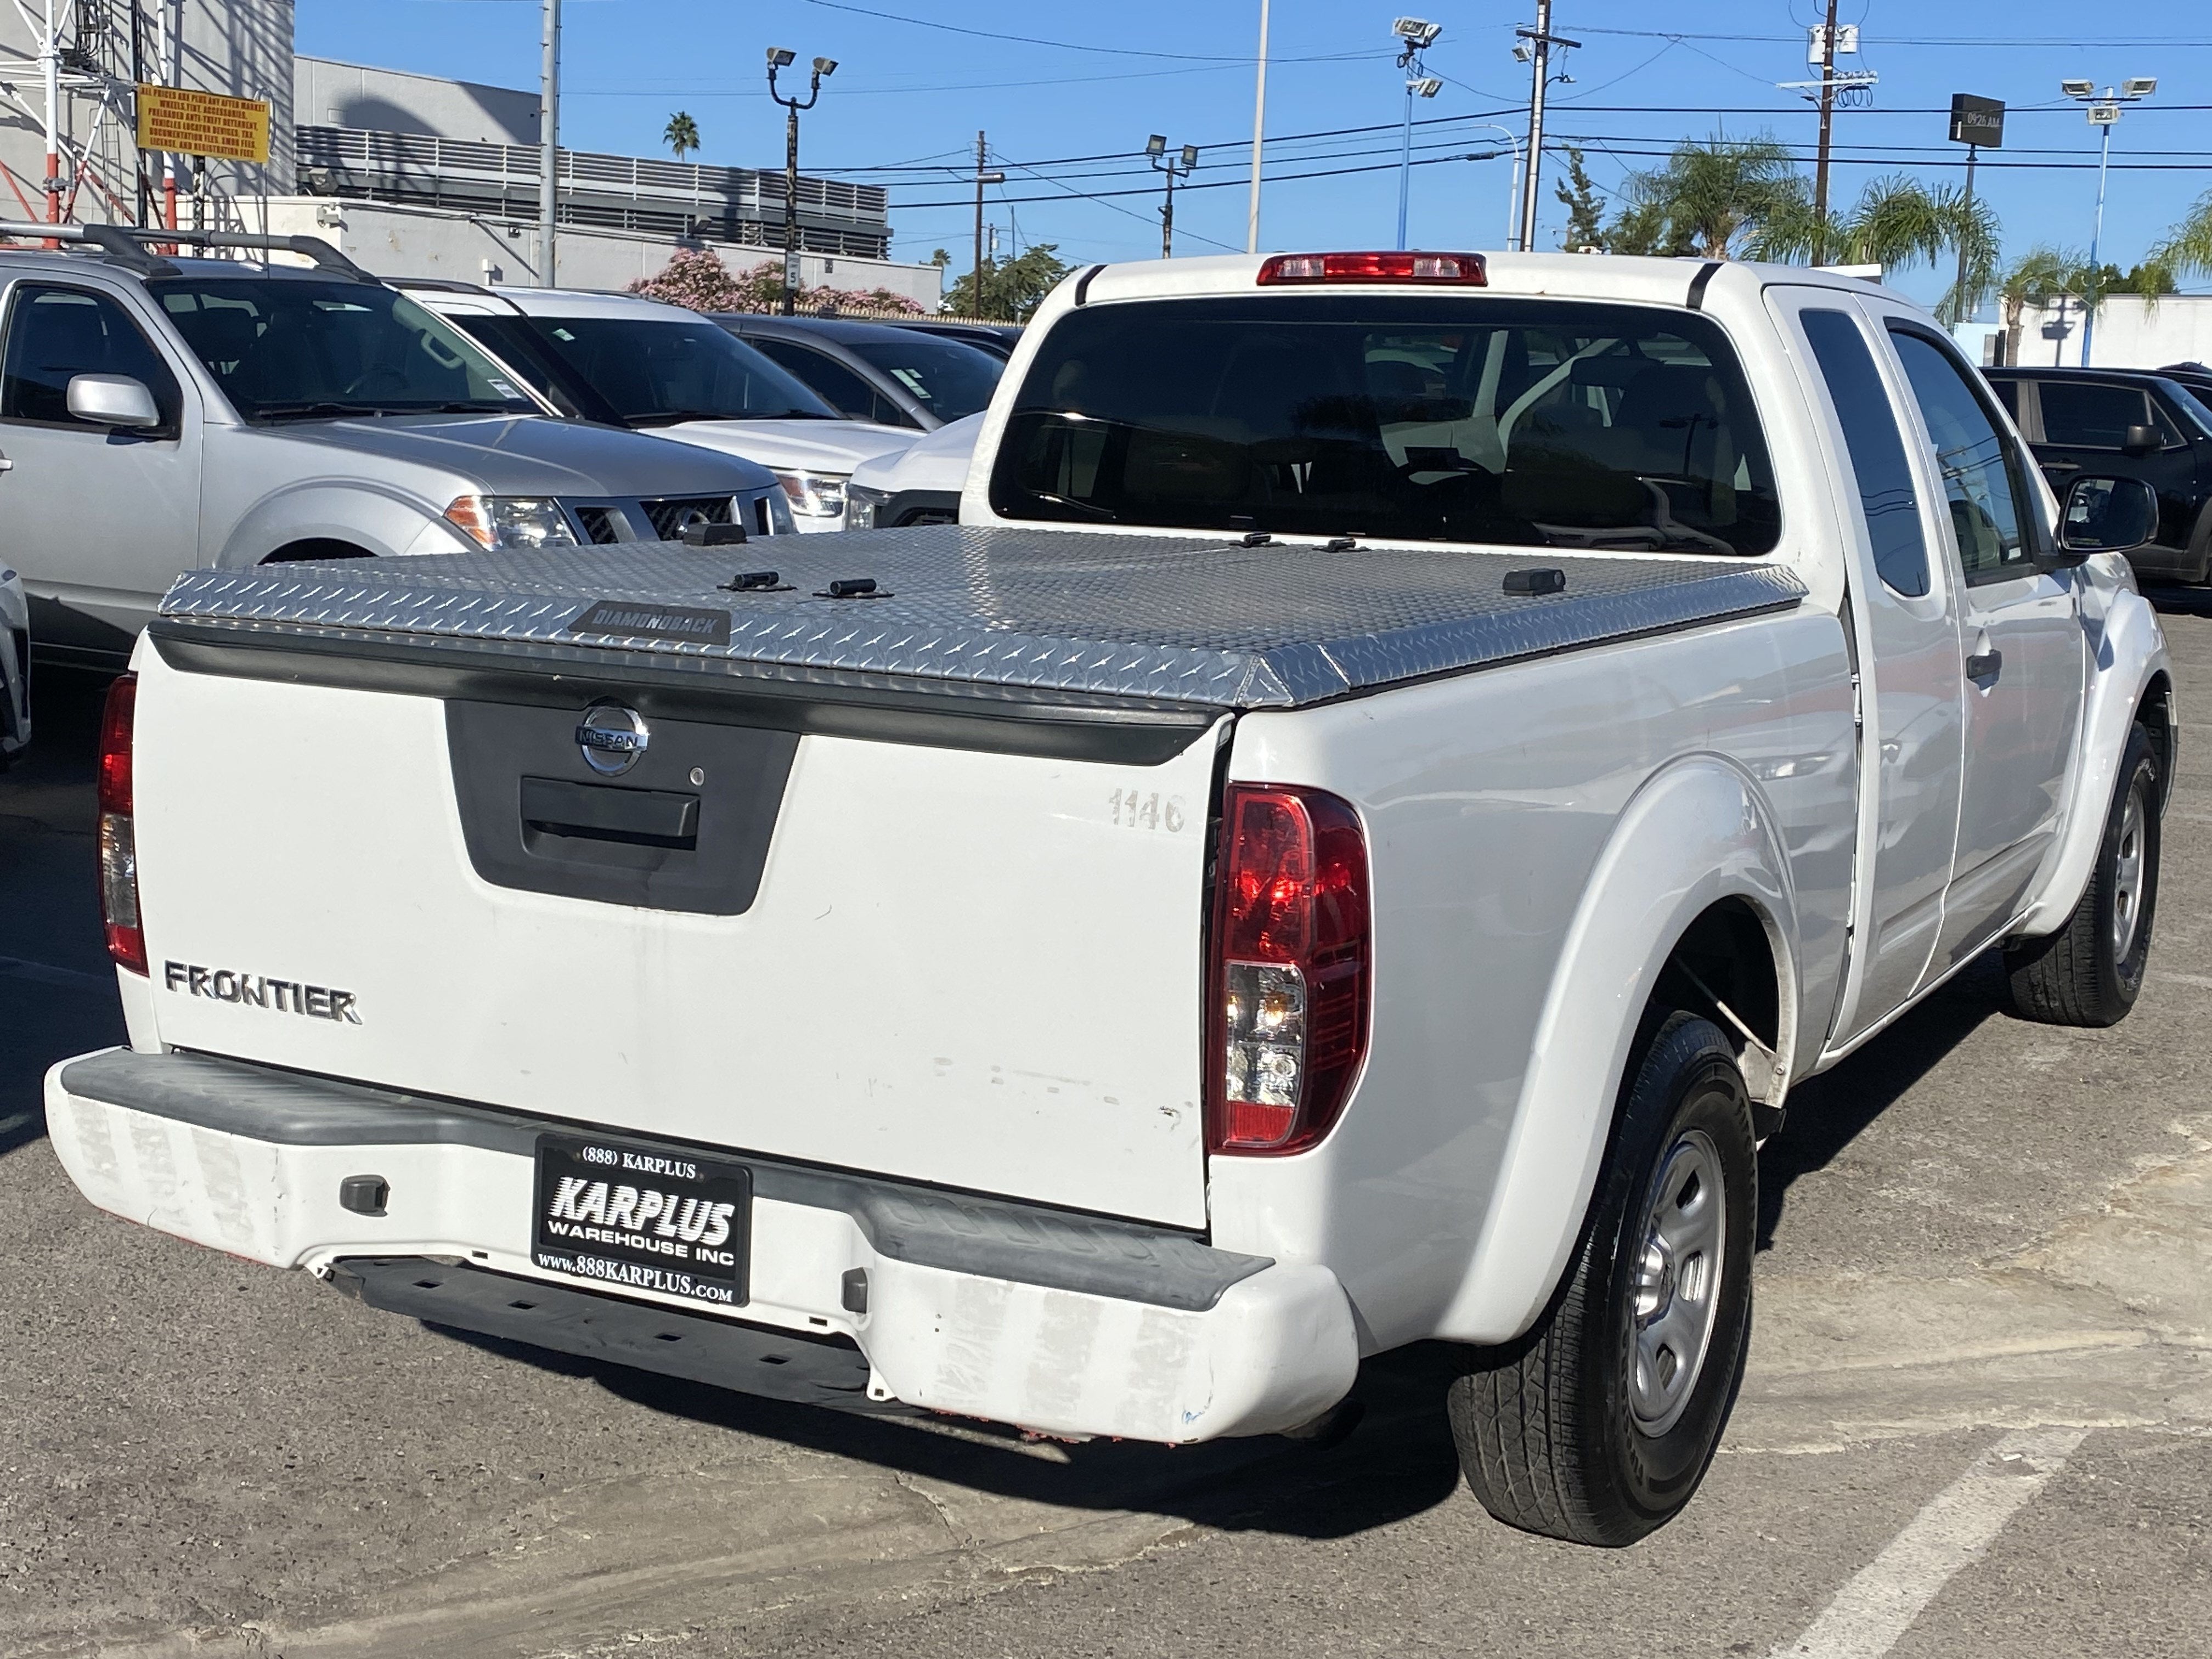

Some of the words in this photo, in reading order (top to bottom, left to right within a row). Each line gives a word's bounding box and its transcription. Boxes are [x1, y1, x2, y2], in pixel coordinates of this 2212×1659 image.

[141, 87, 151, 96] ALL
[154, 89, 176, 99] PRICES
[178, 93, 190, 101] ARE
[192, 94, 206, 104] PLUS
[208, 97, 220, 106] ANY
[222, 99, 239, 109] AFTER
[241, 101, 265, 112] MARKET
[149, 127, 202, 142] DOCUMENTATION
[183, 122, 211, 133] LOCATOR
[179, 140, 191, 150] AND
[194, 143, 238, 156] REGISTRATION
[790, 272, 796, 283] 5
[591, 609, 719, 634] DIAMONDBACK
[578, 729, 638, 751] NISSAN
[164, 960, 363, 1025] FRONTIER
[582, 1146, 618, 1166] (888)
[622, 1152, 696, 1179] KARPLUS
[547, 1176, 735, 1246] KARPLUS
[547, 1220, 688, 1257] WAREHOUSE
[696, 1248, 735, 1266] INC
